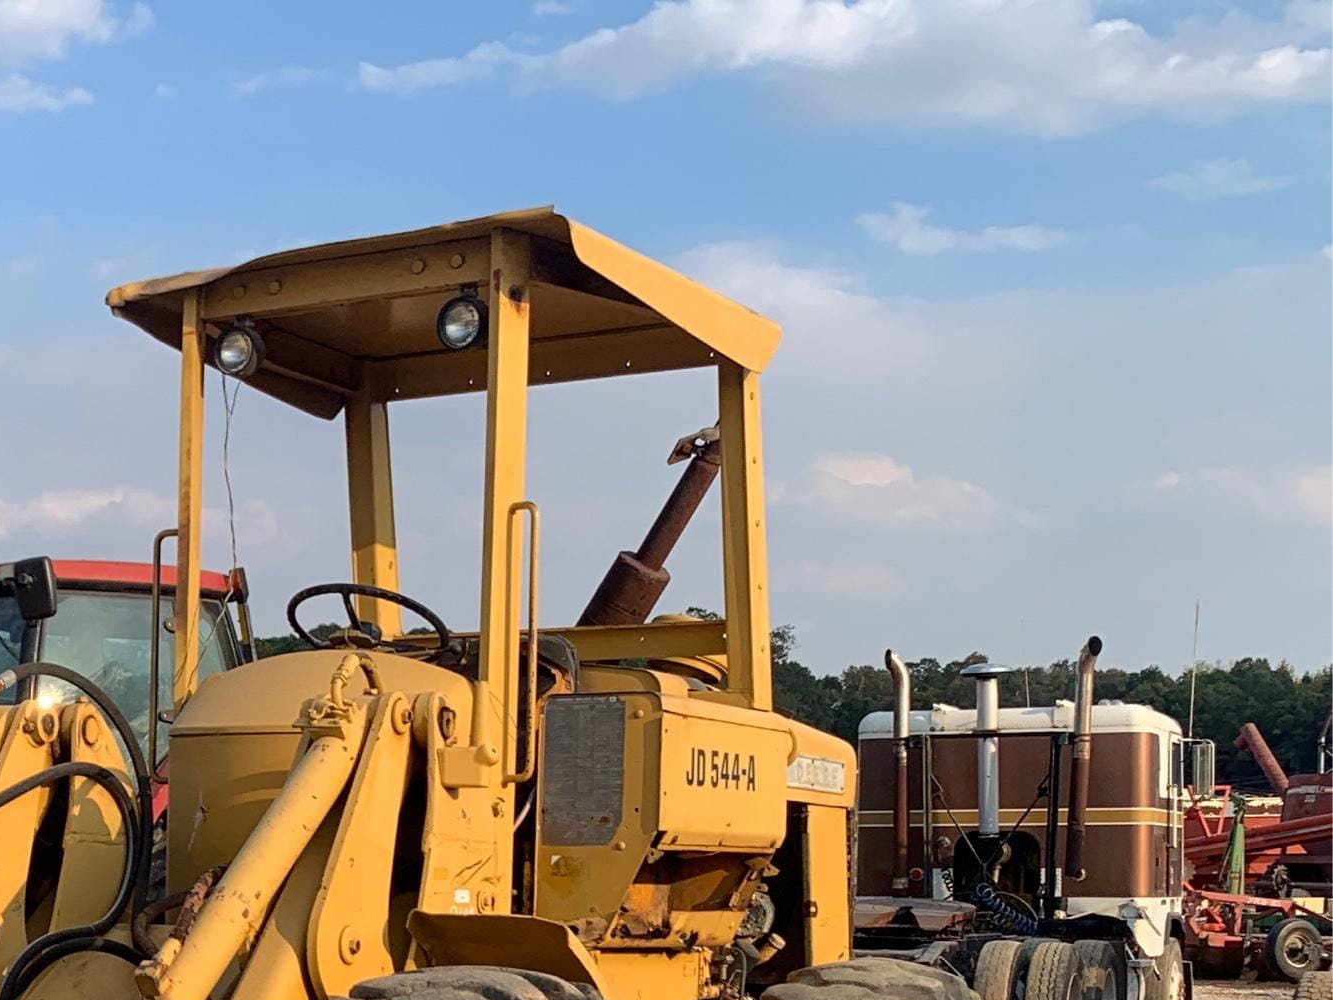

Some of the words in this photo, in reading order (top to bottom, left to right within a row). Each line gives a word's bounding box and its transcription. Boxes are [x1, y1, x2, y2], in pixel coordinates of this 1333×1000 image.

[686, 747, 706, 786] JD
[711, 750, 756, 792] 544-A
[796, 760, 839, 788] DEERE
